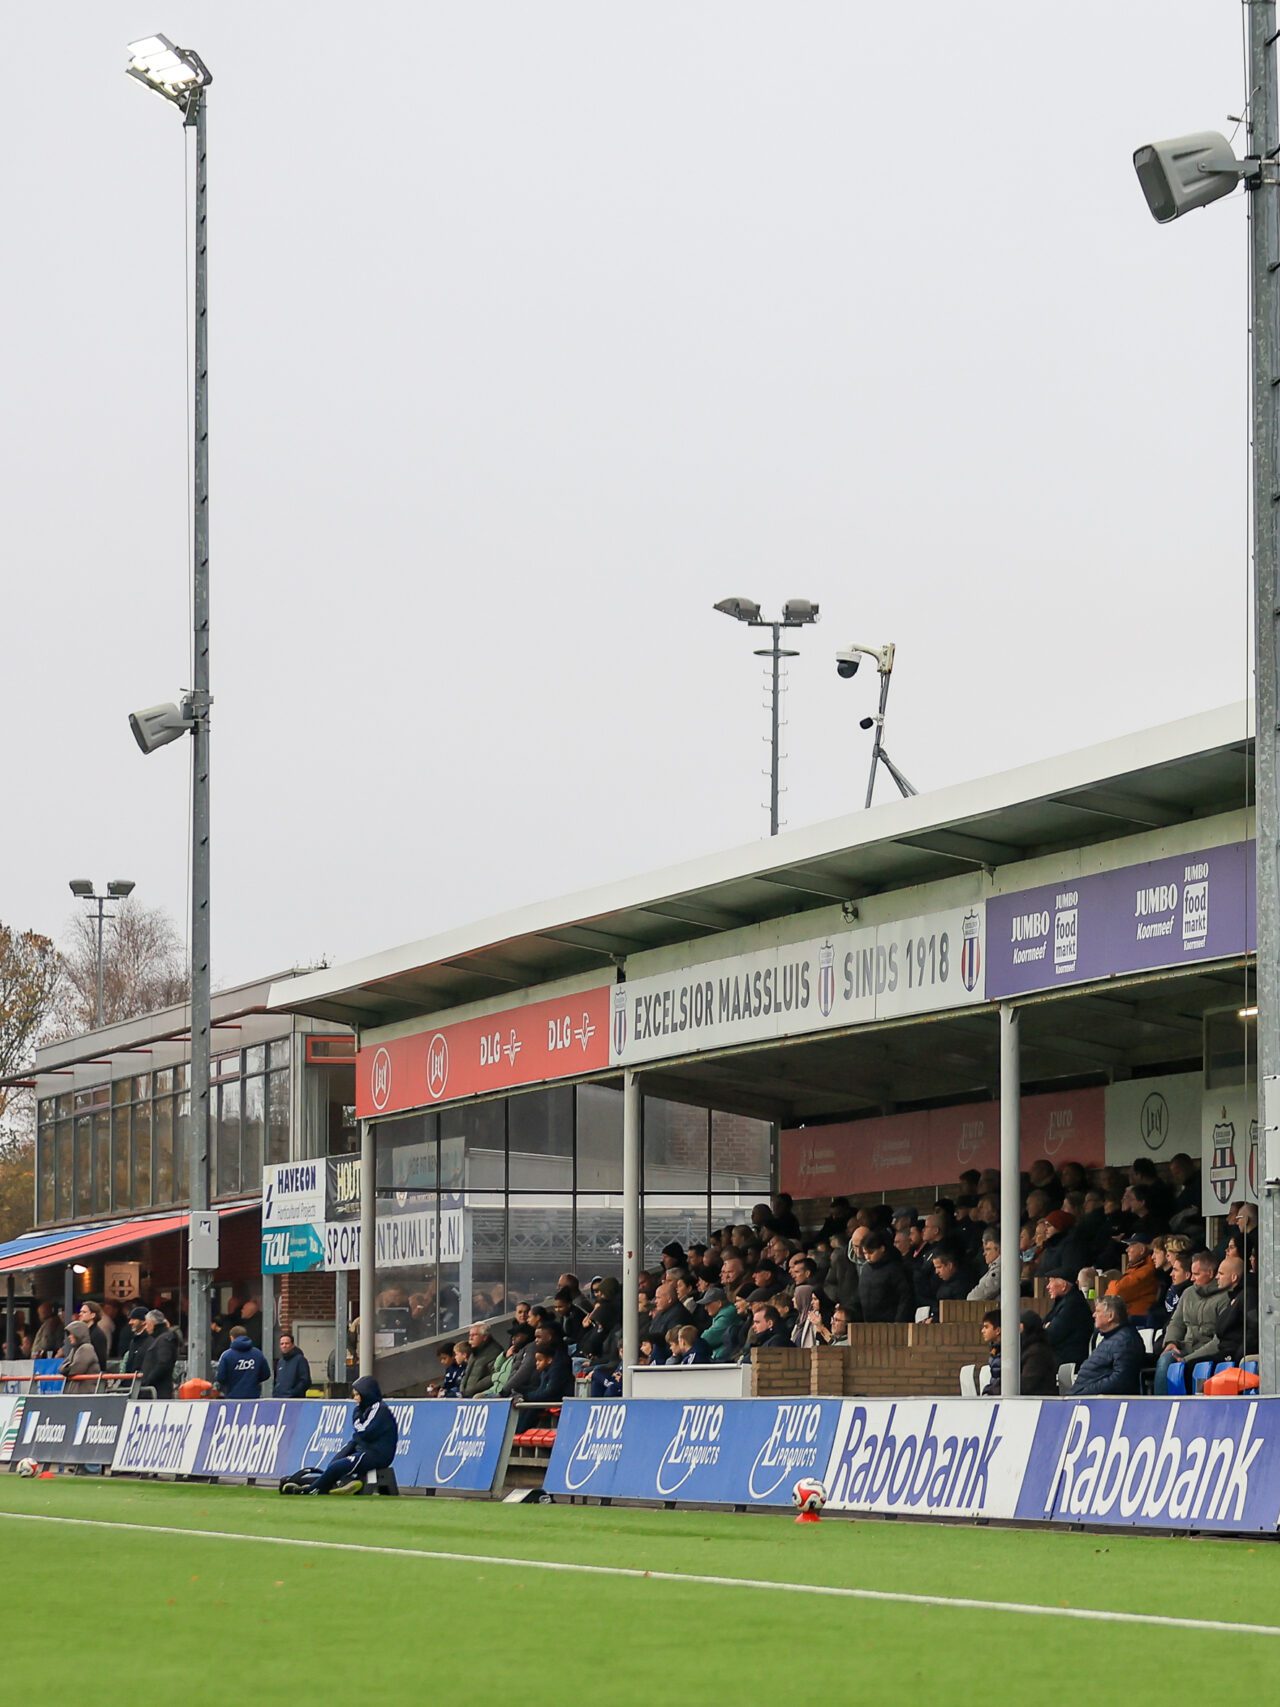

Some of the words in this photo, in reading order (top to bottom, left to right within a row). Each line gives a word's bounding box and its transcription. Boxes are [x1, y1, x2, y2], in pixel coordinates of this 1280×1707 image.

[1183, 863, 1209, 882] JUMBO
[1055, 891, 1079, 910] JUMBO
[1135, 883, 1178, 917] JUMBO
[1184, 887, 1206, 913] food
[1011, 910, 1050, 943] JUMBO
[1056, 914, 1076, 939] food
[1137, 915, 1175, 941] Koornneef
[1184, 916, 1206, 933] markt
[1012, 941, 1047, 965] Koornneef
[1056, 942, 1076, 958] markt
[634, 980, 713, 1040] EXCELSIOR
[719, 960, 810, 1023] MAASSLUIS
[844, 941, 898, 1001] SINDS
[905, 932, 949, 989] 1918
[480, 1030, 500, 1066] DLG
[548, 1015, 571, 1051] DLG
[277, 1165, 316, 1194] HAVECON
[119, 1404, 193, 1470] Rabobank
[203, 1404, 286, 1474] Rabobank
[828, 1403, 1002, 1509] Rabobank
[1045, 1401, 1265, 1521] Rabobank
